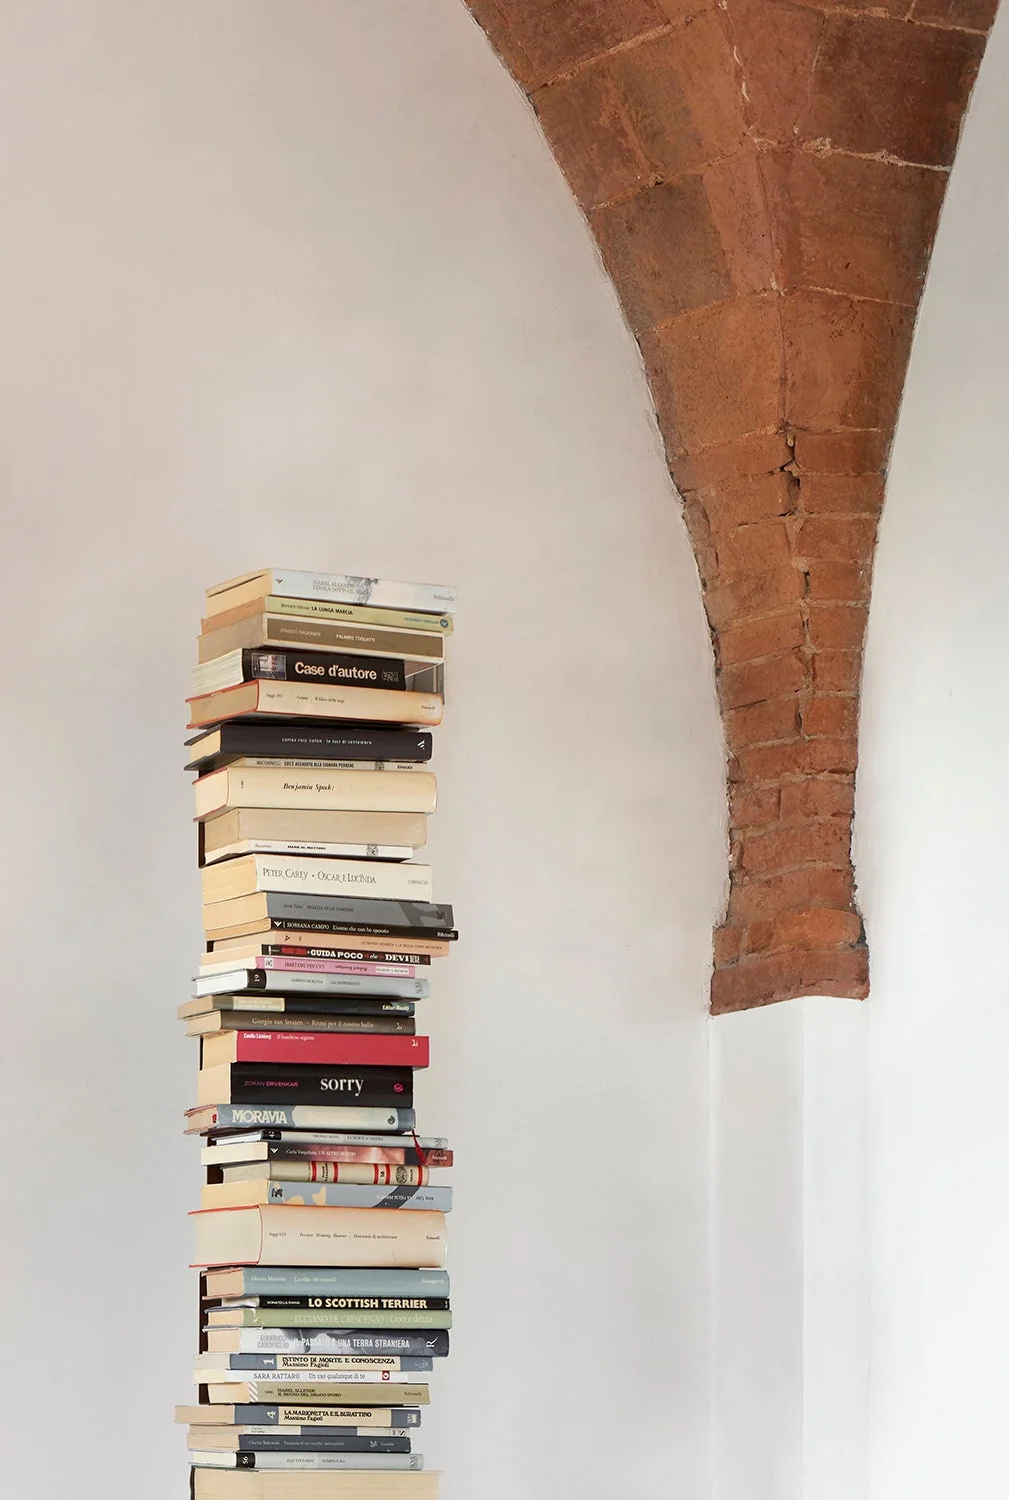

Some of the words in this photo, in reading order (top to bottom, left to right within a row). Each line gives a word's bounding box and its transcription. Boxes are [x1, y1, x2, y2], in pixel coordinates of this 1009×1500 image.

[294, 662, 324, 676] Case
[328, 664, 377, 680] d'autore
[283, 783, 313, 791] Benjamin
[263, 868, 284, 878] PETER
[285, 869, 308, 880] CAREY
[318, 872, 342, 882] OSCAR
[348, 873, 376, 884] LUCINDA
[310, 949, 336, 958] GUIDA
[337, 951, 363, 960] POCO
[385, 954, 409, 963] DEVI
[320, 1078, 364, 1096] sorry
[232, 1110, 288, 1124] MORAVIA
[308, 1298, 323, 1308] LO
[325, 1299, 379, 1308] SCOTTISH
[381, 1300, 428, 1309] TERRIER
[337, 1339, 351, 1348] UNA
[353, 1339, 373, 1348] TERRA
[375, 1339, 410, 1348] STRANIERA
[242, 1456, 248, 1464] 56
